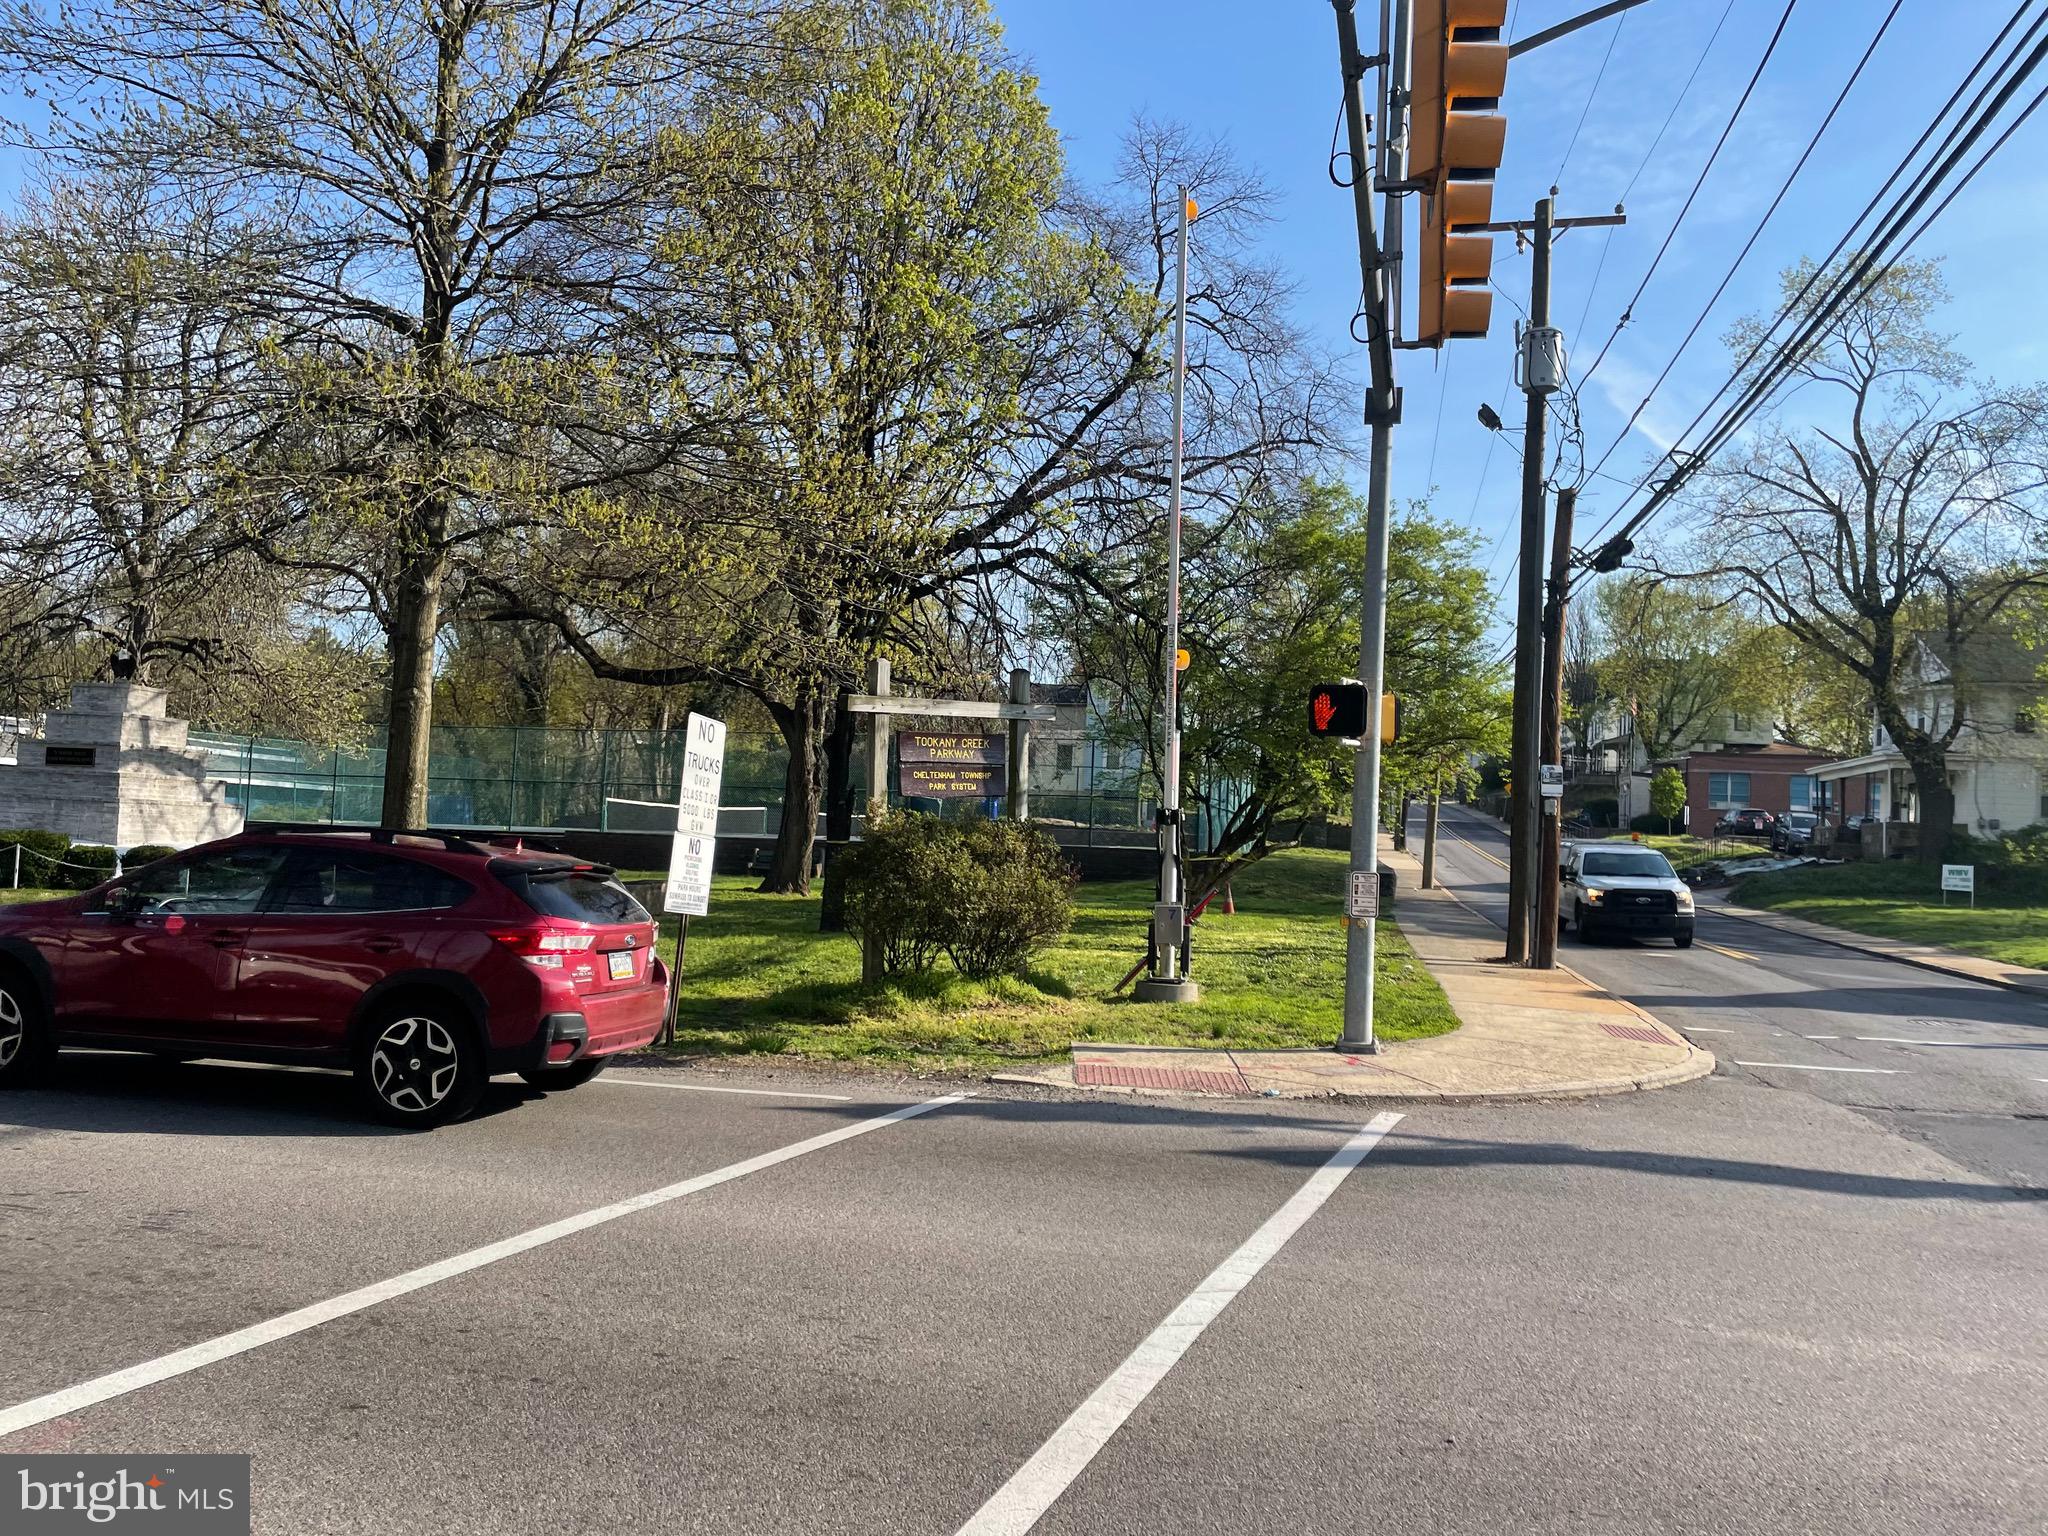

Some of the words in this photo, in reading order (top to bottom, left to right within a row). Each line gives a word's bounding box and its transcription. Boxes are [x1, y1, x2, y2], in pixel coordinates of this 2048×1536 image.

[699, 720, 715, 743] NO
[914, 736, 957, 748] TOOKANY
[961, 738, 990, 748] CREEK
[930, 749, 975, 759] PARKWAY
[688, 751, 720, 774] TRUCKS
[694, 774, 710, 787] OVER
[913, 771, 956, 779] CHELTENHAM
[960, 771, 992, 780] TOWNSHIP
[928, 782, 946, 791] PARK
[951, 782, 977, 791] SYSTEM
[682, 787, 703, 801] CLASS
[683, 803, 699, 816] 5000
[703, 807, 715, 819] LBS
[688, 837, 701, 855] NO
